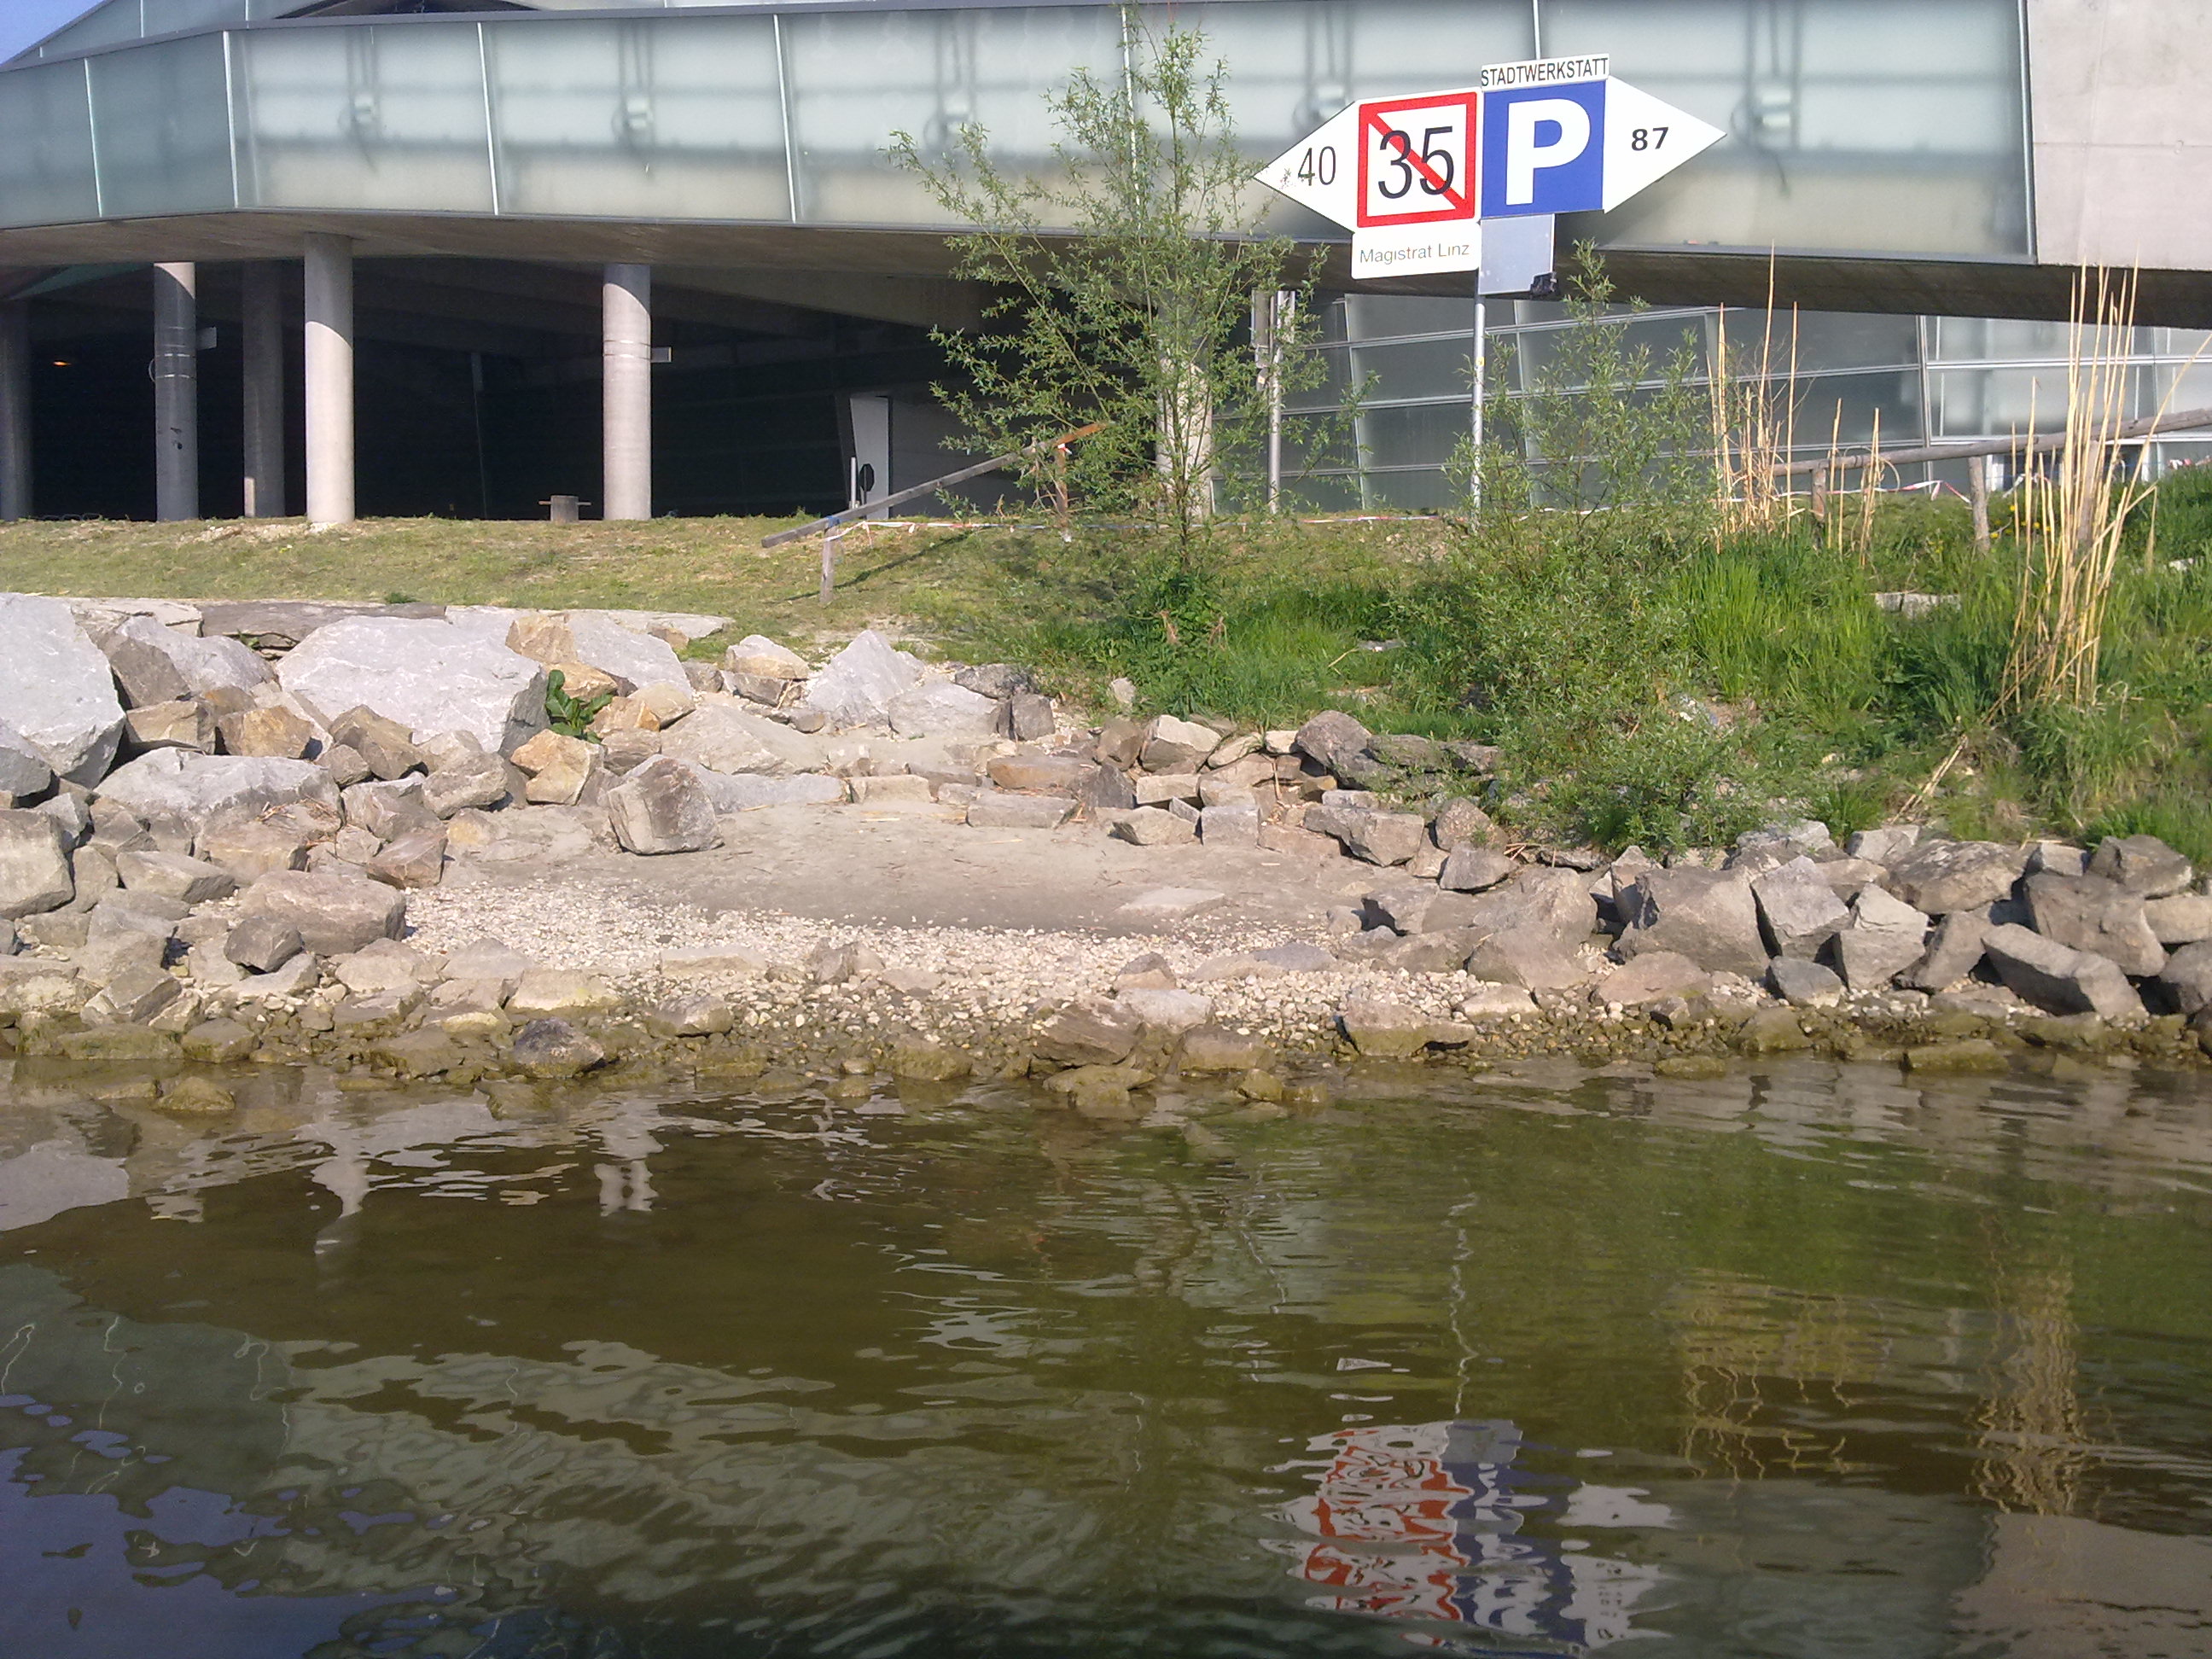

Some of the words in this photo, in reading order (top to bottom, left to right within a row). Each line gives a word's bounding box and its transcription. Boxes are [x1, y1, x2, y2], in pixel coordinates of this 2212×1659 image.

[1481, 58, 1608, 86] STADTWERKSTATT
[1505, 98, 1591, 205] P
[1631, 127, 1669, 151] 87
[1297, 146, 1336, 186] 40
[1378, 126, 1454, 199] 35
[1359, 245, 1432, 265] Magistrat
[1438, 243, 1470, 257] Linz
